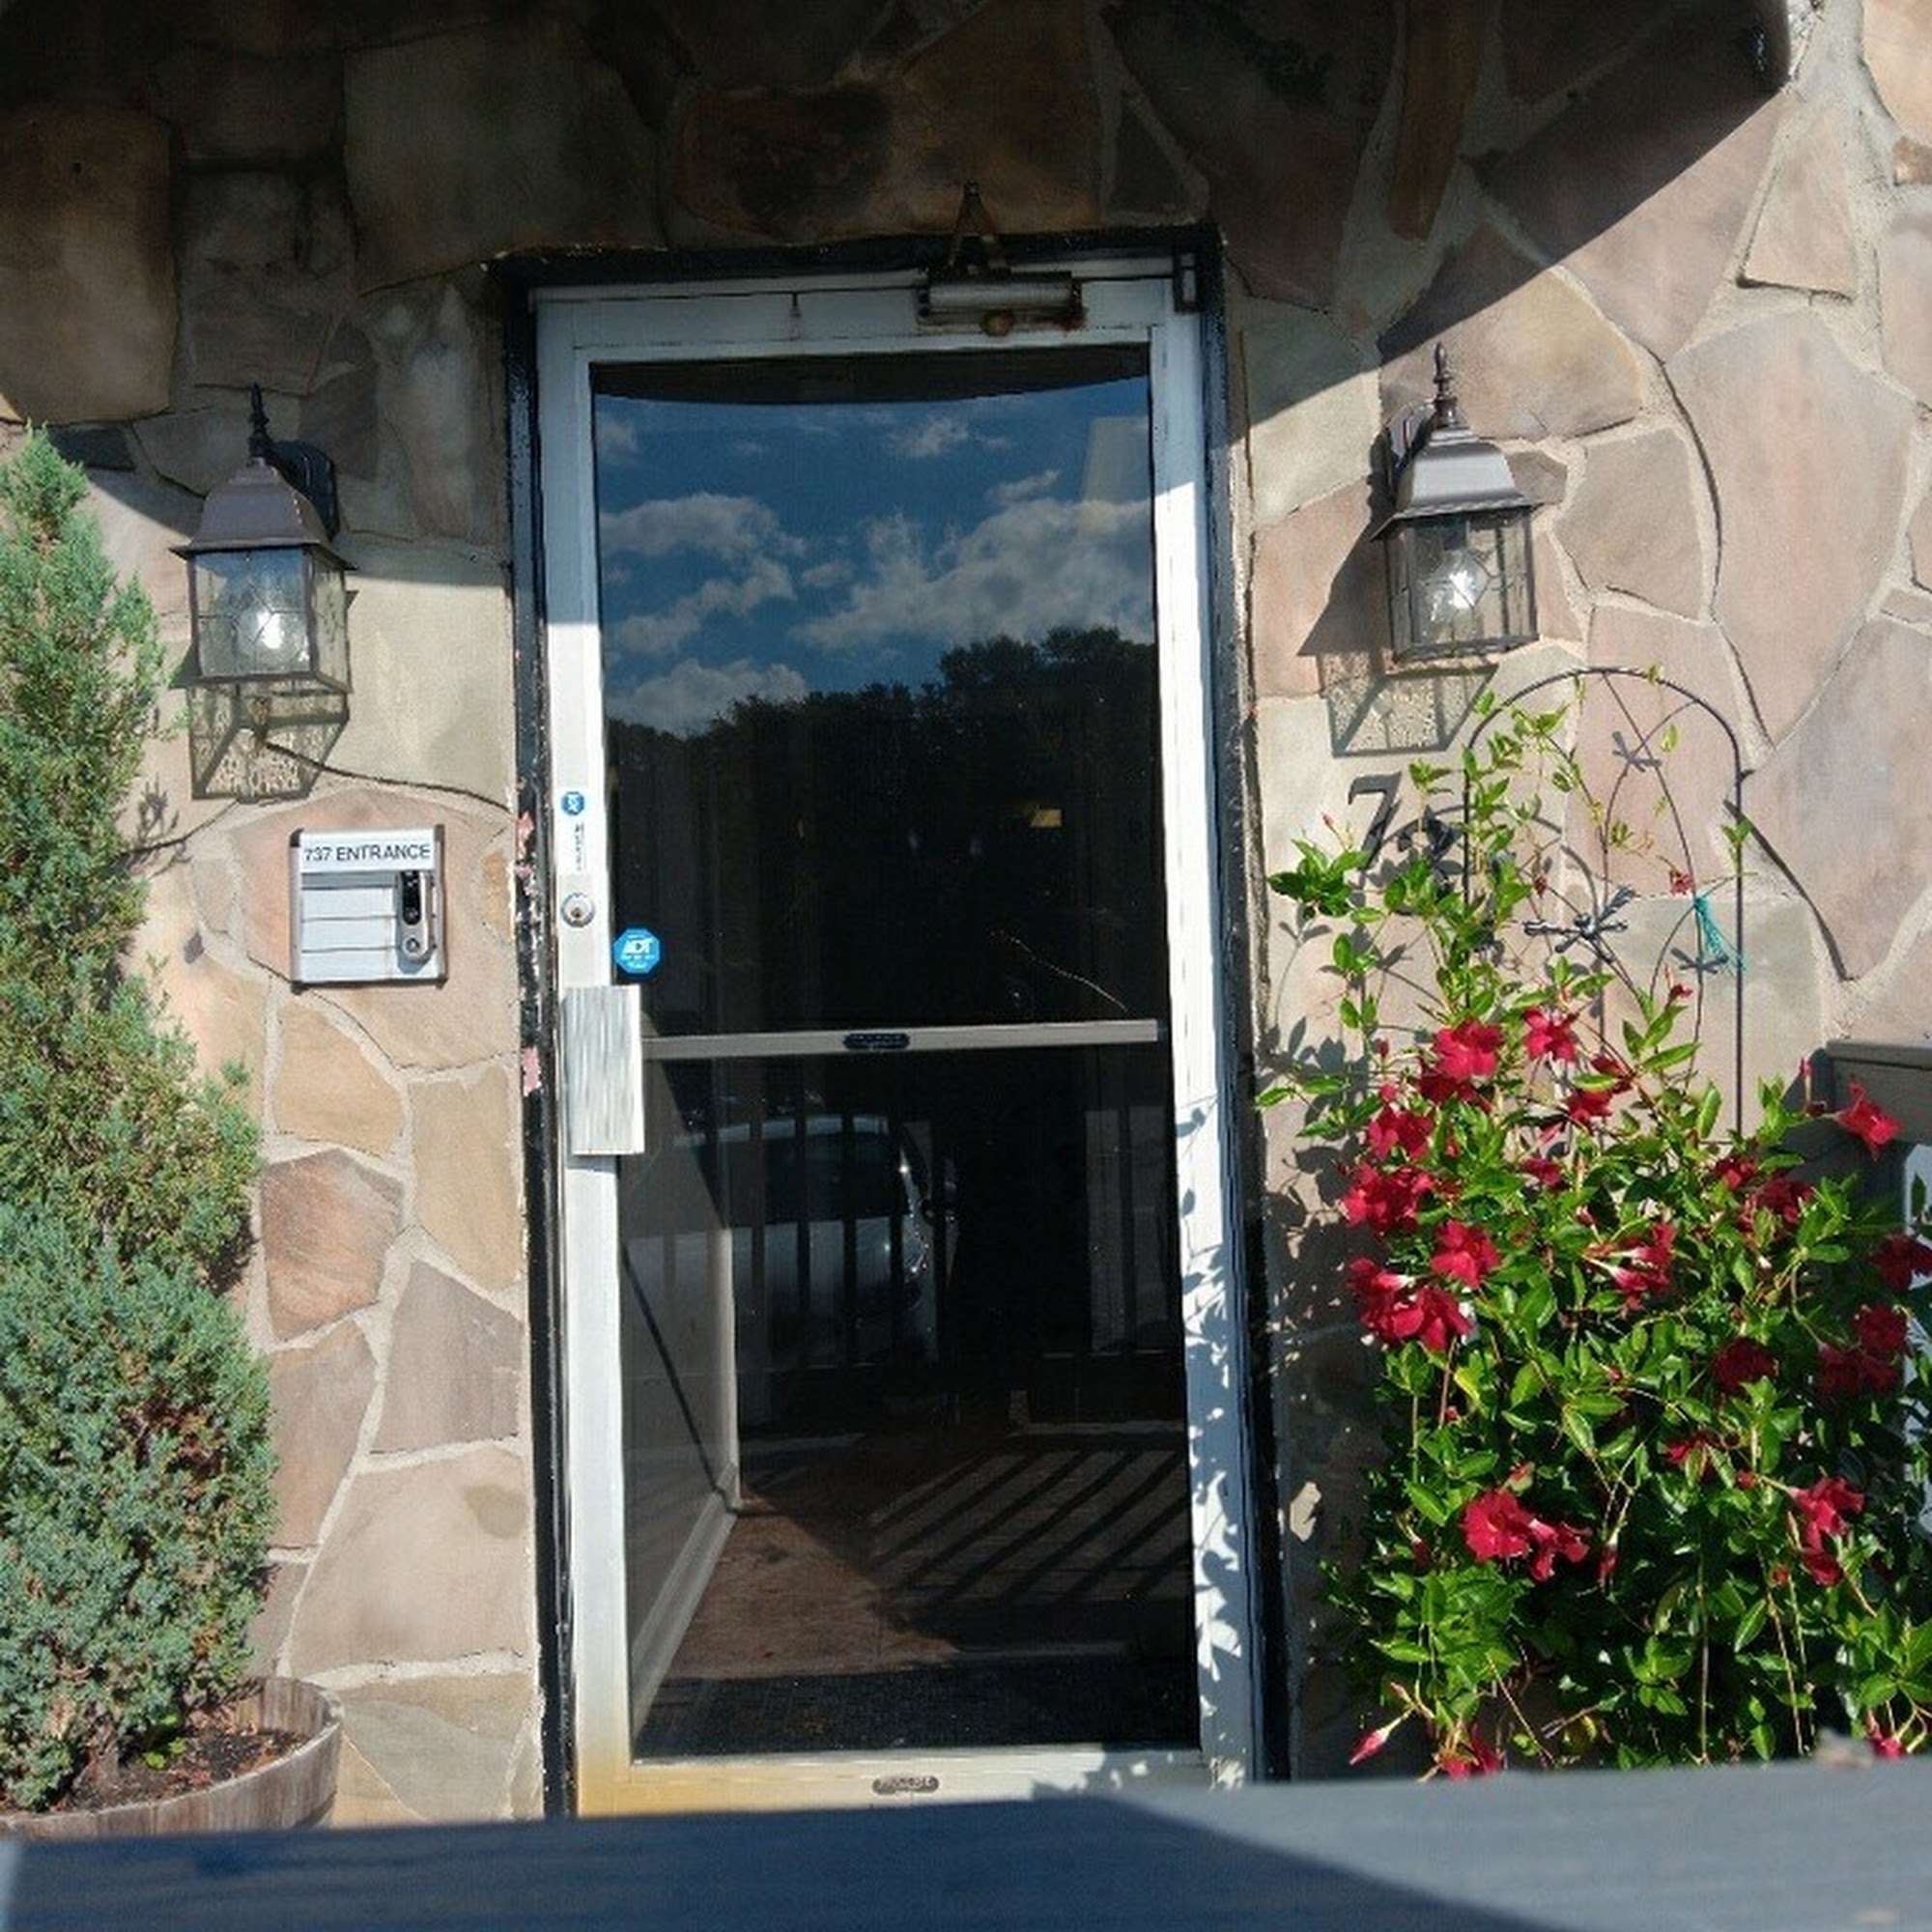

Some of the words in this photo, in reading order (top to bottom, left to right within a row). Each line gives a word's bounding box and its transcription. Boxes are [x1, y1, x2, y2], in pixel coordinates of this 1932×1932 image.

[304, 846, 332, 862] 737
[336, 844, 431, 861] ENTRANCE
[622, 938, 653, 954] ADT
